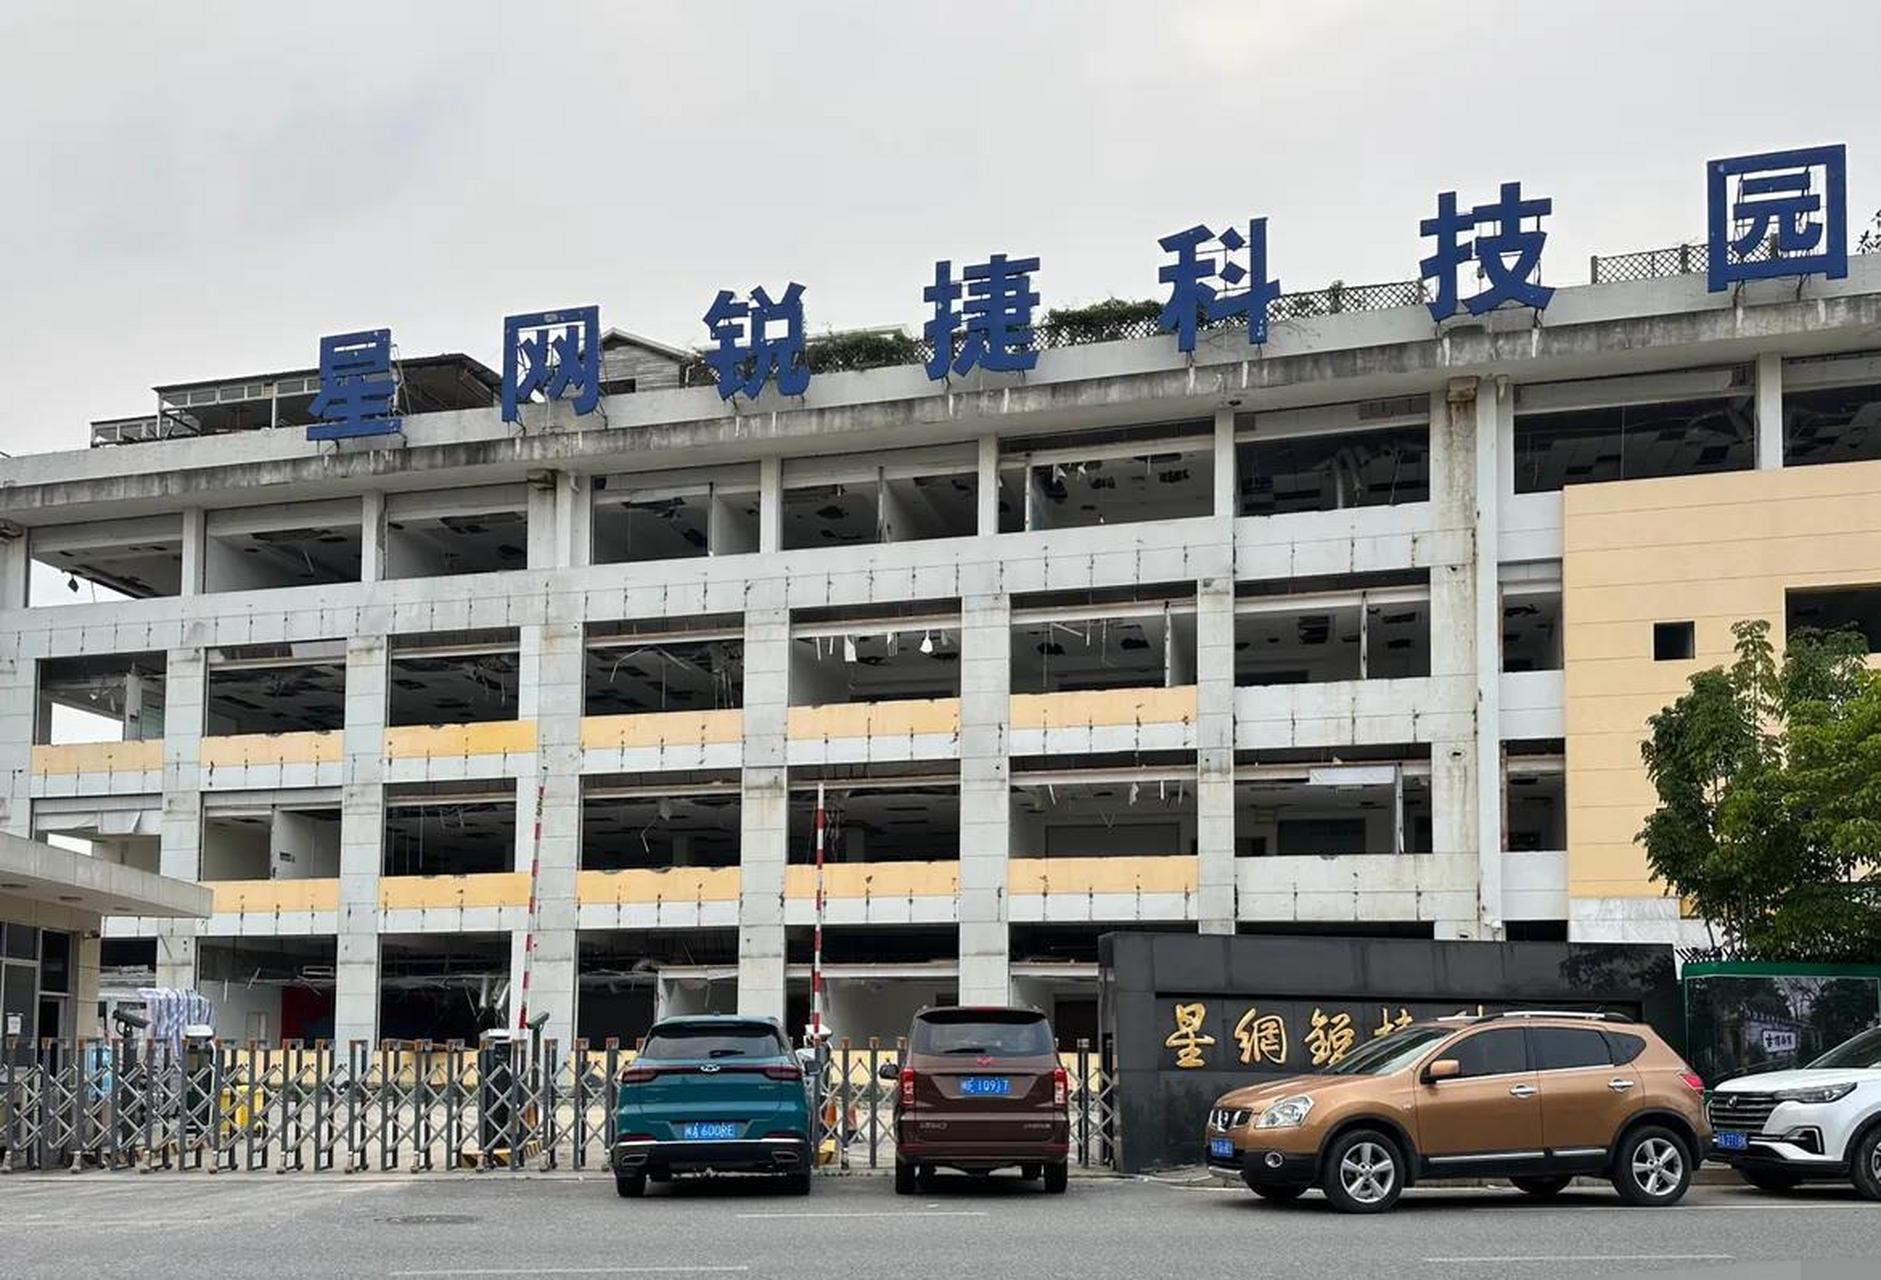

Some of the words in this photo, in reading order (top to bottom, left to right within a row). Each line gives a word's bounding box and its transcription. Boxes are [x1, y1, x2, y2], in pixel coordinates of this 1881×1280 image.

[306, 144, 1848, 442] 星网锐捷科技园
